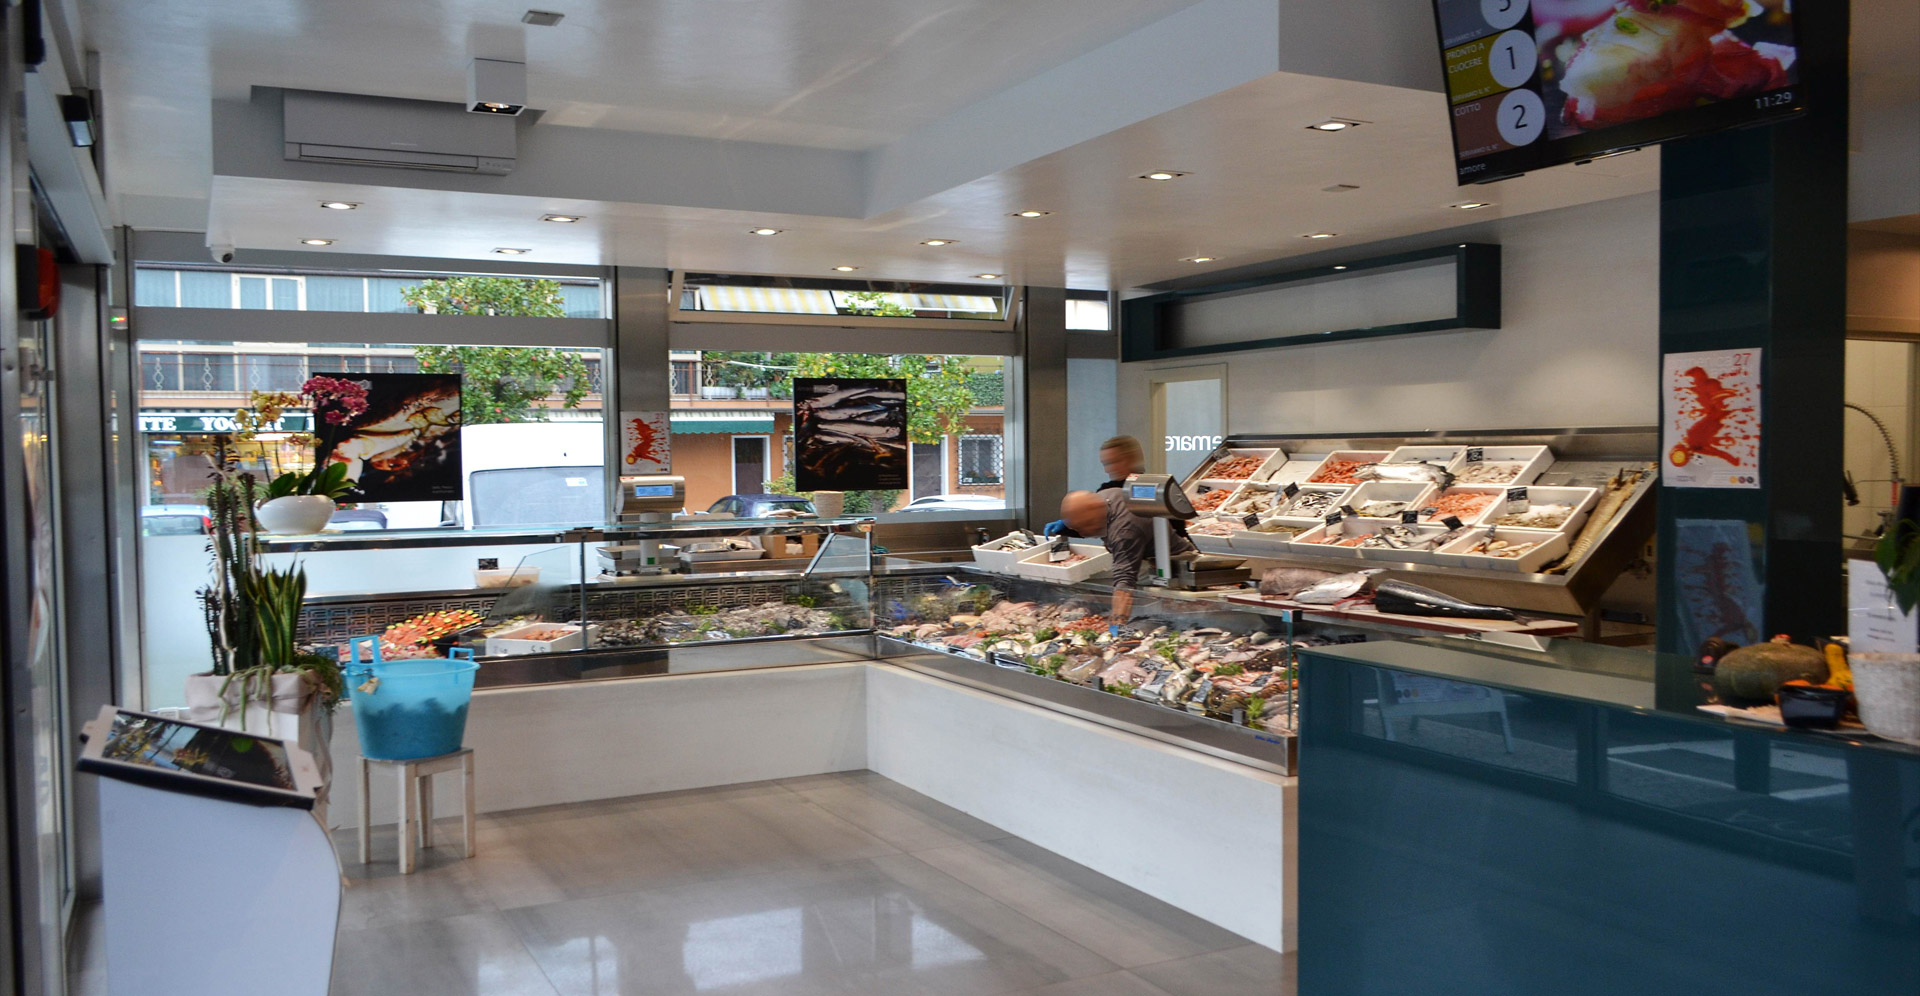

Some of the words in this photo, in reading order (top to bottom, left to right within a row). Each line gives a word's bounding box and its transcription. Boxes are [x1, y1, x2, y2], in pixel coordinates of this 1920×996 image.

[1446, 44, 1478, 60] PRONTO
[1479, 42, 1486, 51] A
[1505, 46, 1516, 70] 1
[1447, 57, 1483, 74] CUOCERE
[1454, 102, 1482, 117] COTTO
[1754, 92, 1792, 110] 11:29
[1512, 104, 1528, 130] 2
[1459, 162, 1487, 175] amore
[1733, 352, 1753, 367] 27
